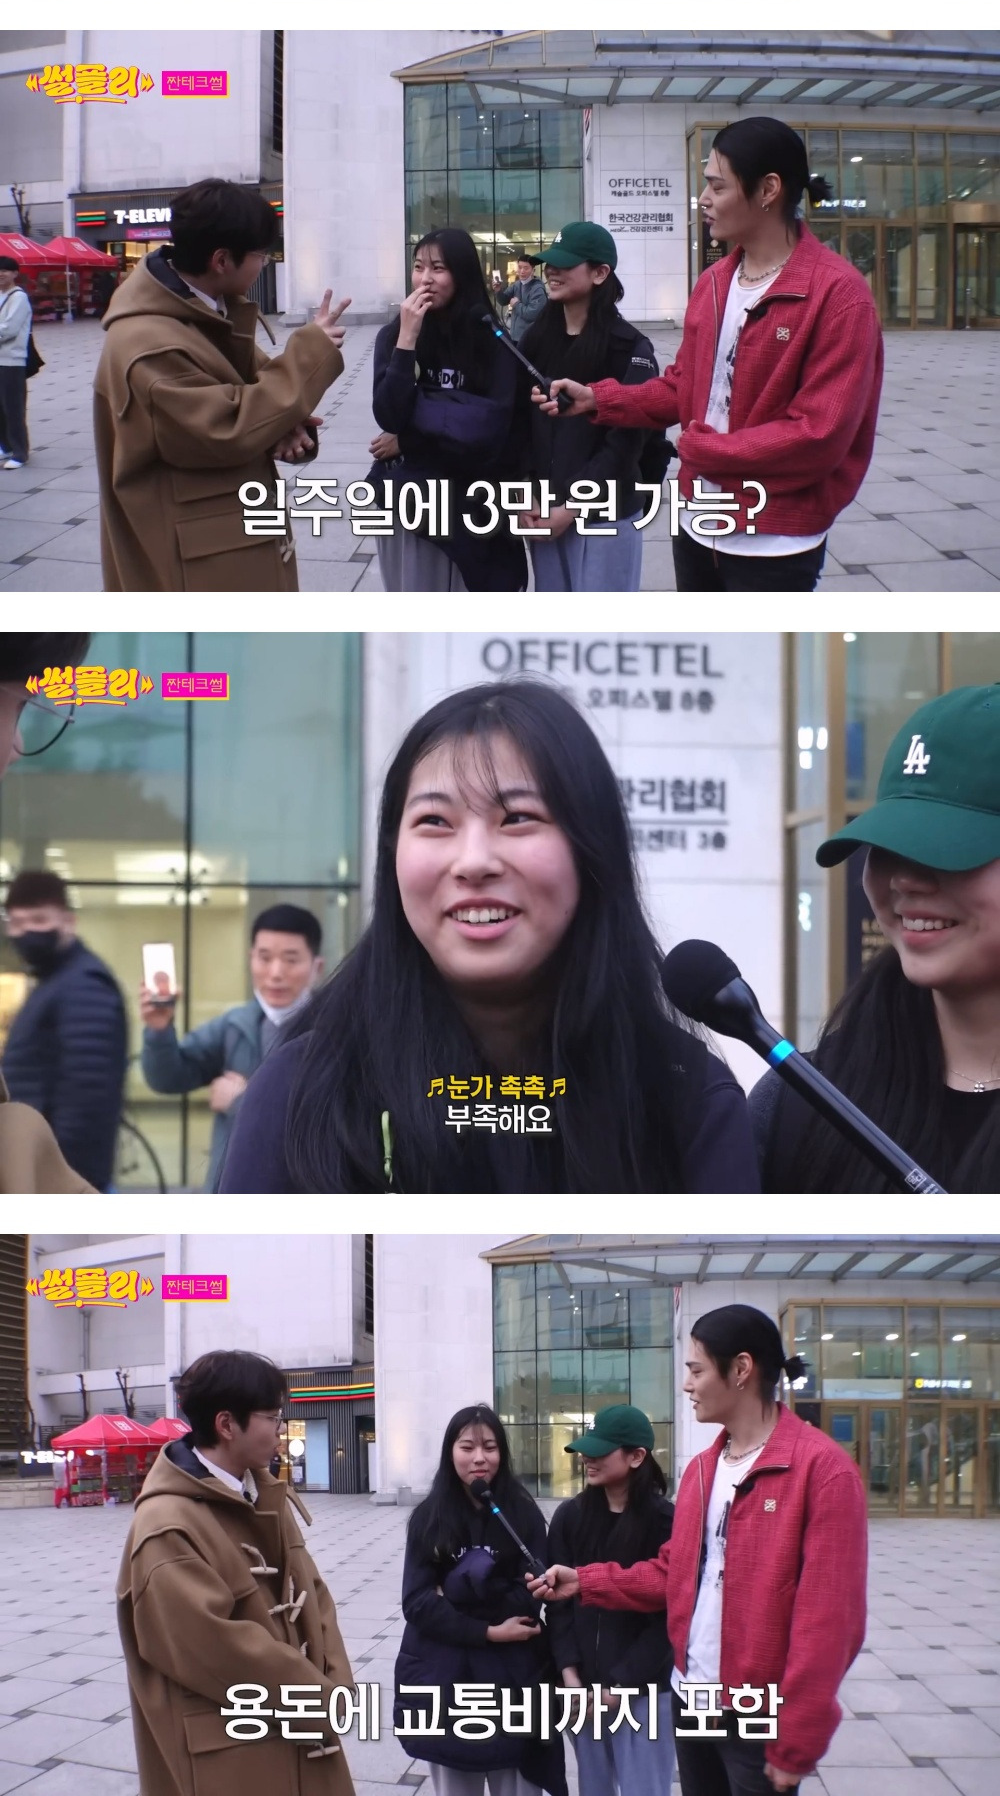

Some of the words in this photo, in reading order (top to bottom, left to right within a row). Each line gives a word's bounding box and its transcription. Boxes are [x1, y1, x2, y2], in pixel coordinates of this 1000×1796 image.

[608, 178, 672, 188] OFFICETEL
[113, 207, 171, 224] 7-ELEV
[608, 212, 673, 223] 한국건강관리협회
[482, 638, 724, 679] OFFICETEL
[902, 734, 931, 775] LA
